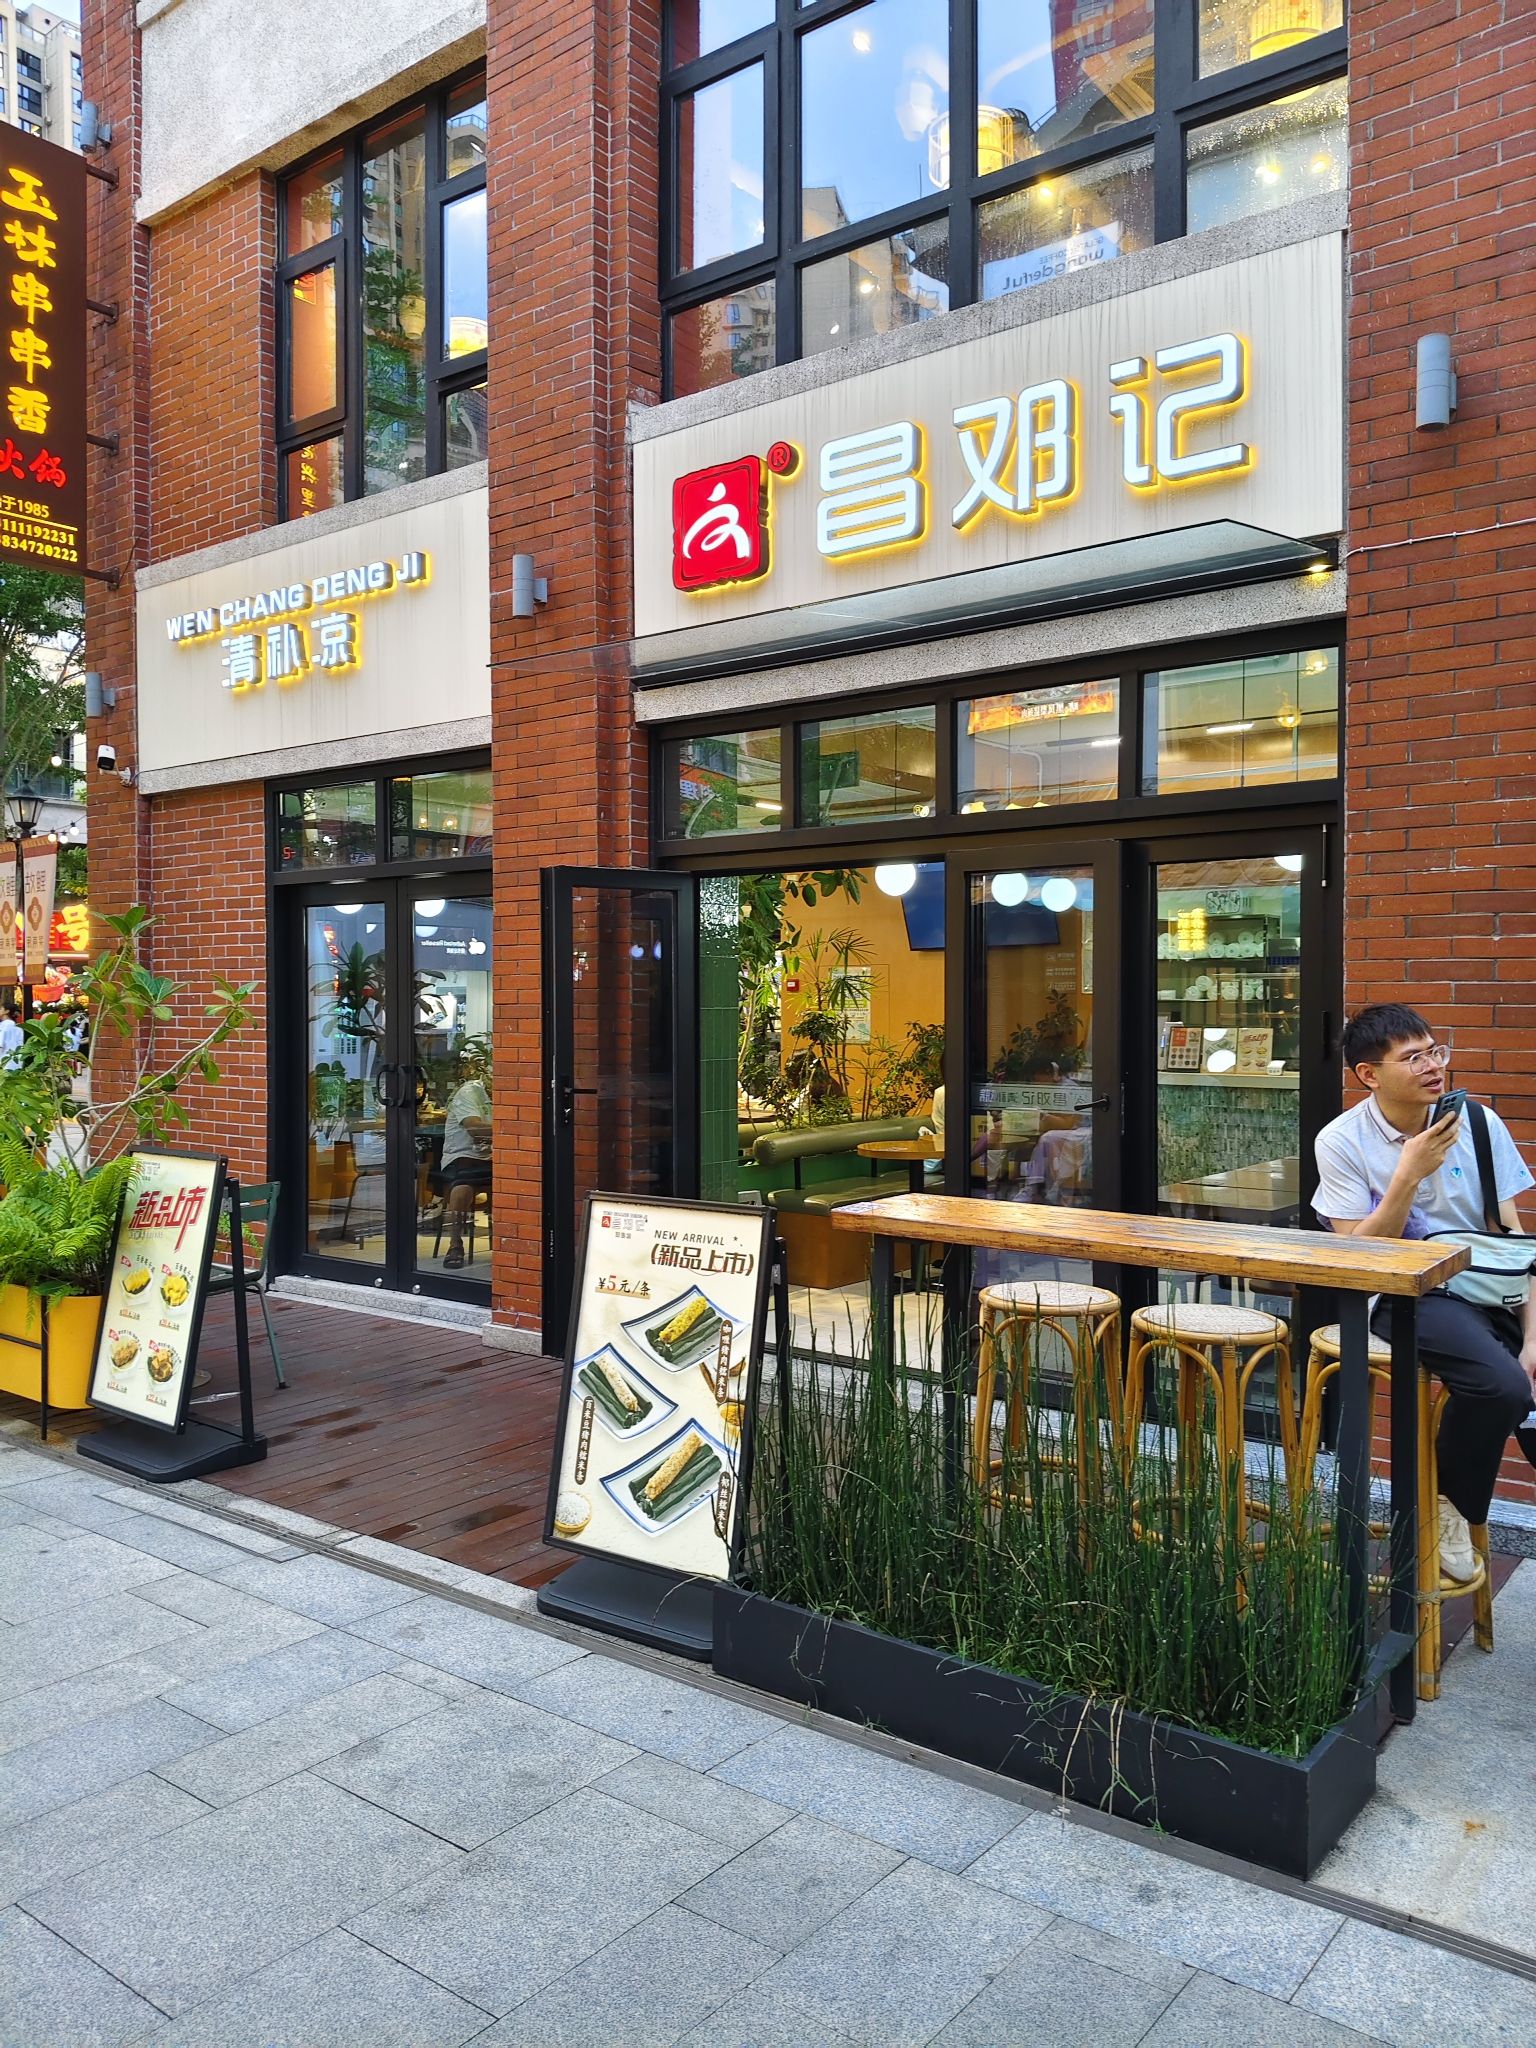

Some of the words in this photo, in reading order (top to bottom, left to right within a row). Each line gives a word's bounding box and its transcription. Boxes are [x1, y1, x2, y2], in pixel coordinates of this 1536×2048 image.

[2, 167, 58, 435] 玉林串串香
[0, 438, 66, 488] 火锅
[816, 332, 1247, 556] 昌邓记
[0, 495, 49, 518] 于1985
[166, 609, 218, 641] WEN
[220, 583, 306, 626] CHANG
[312, 560, 388, 603] DENG
[396, 551, 424, 582] JI
[654, 1229, 678, 1242] NEW
[682, 1232, 725, 1246] ARRIVAL
